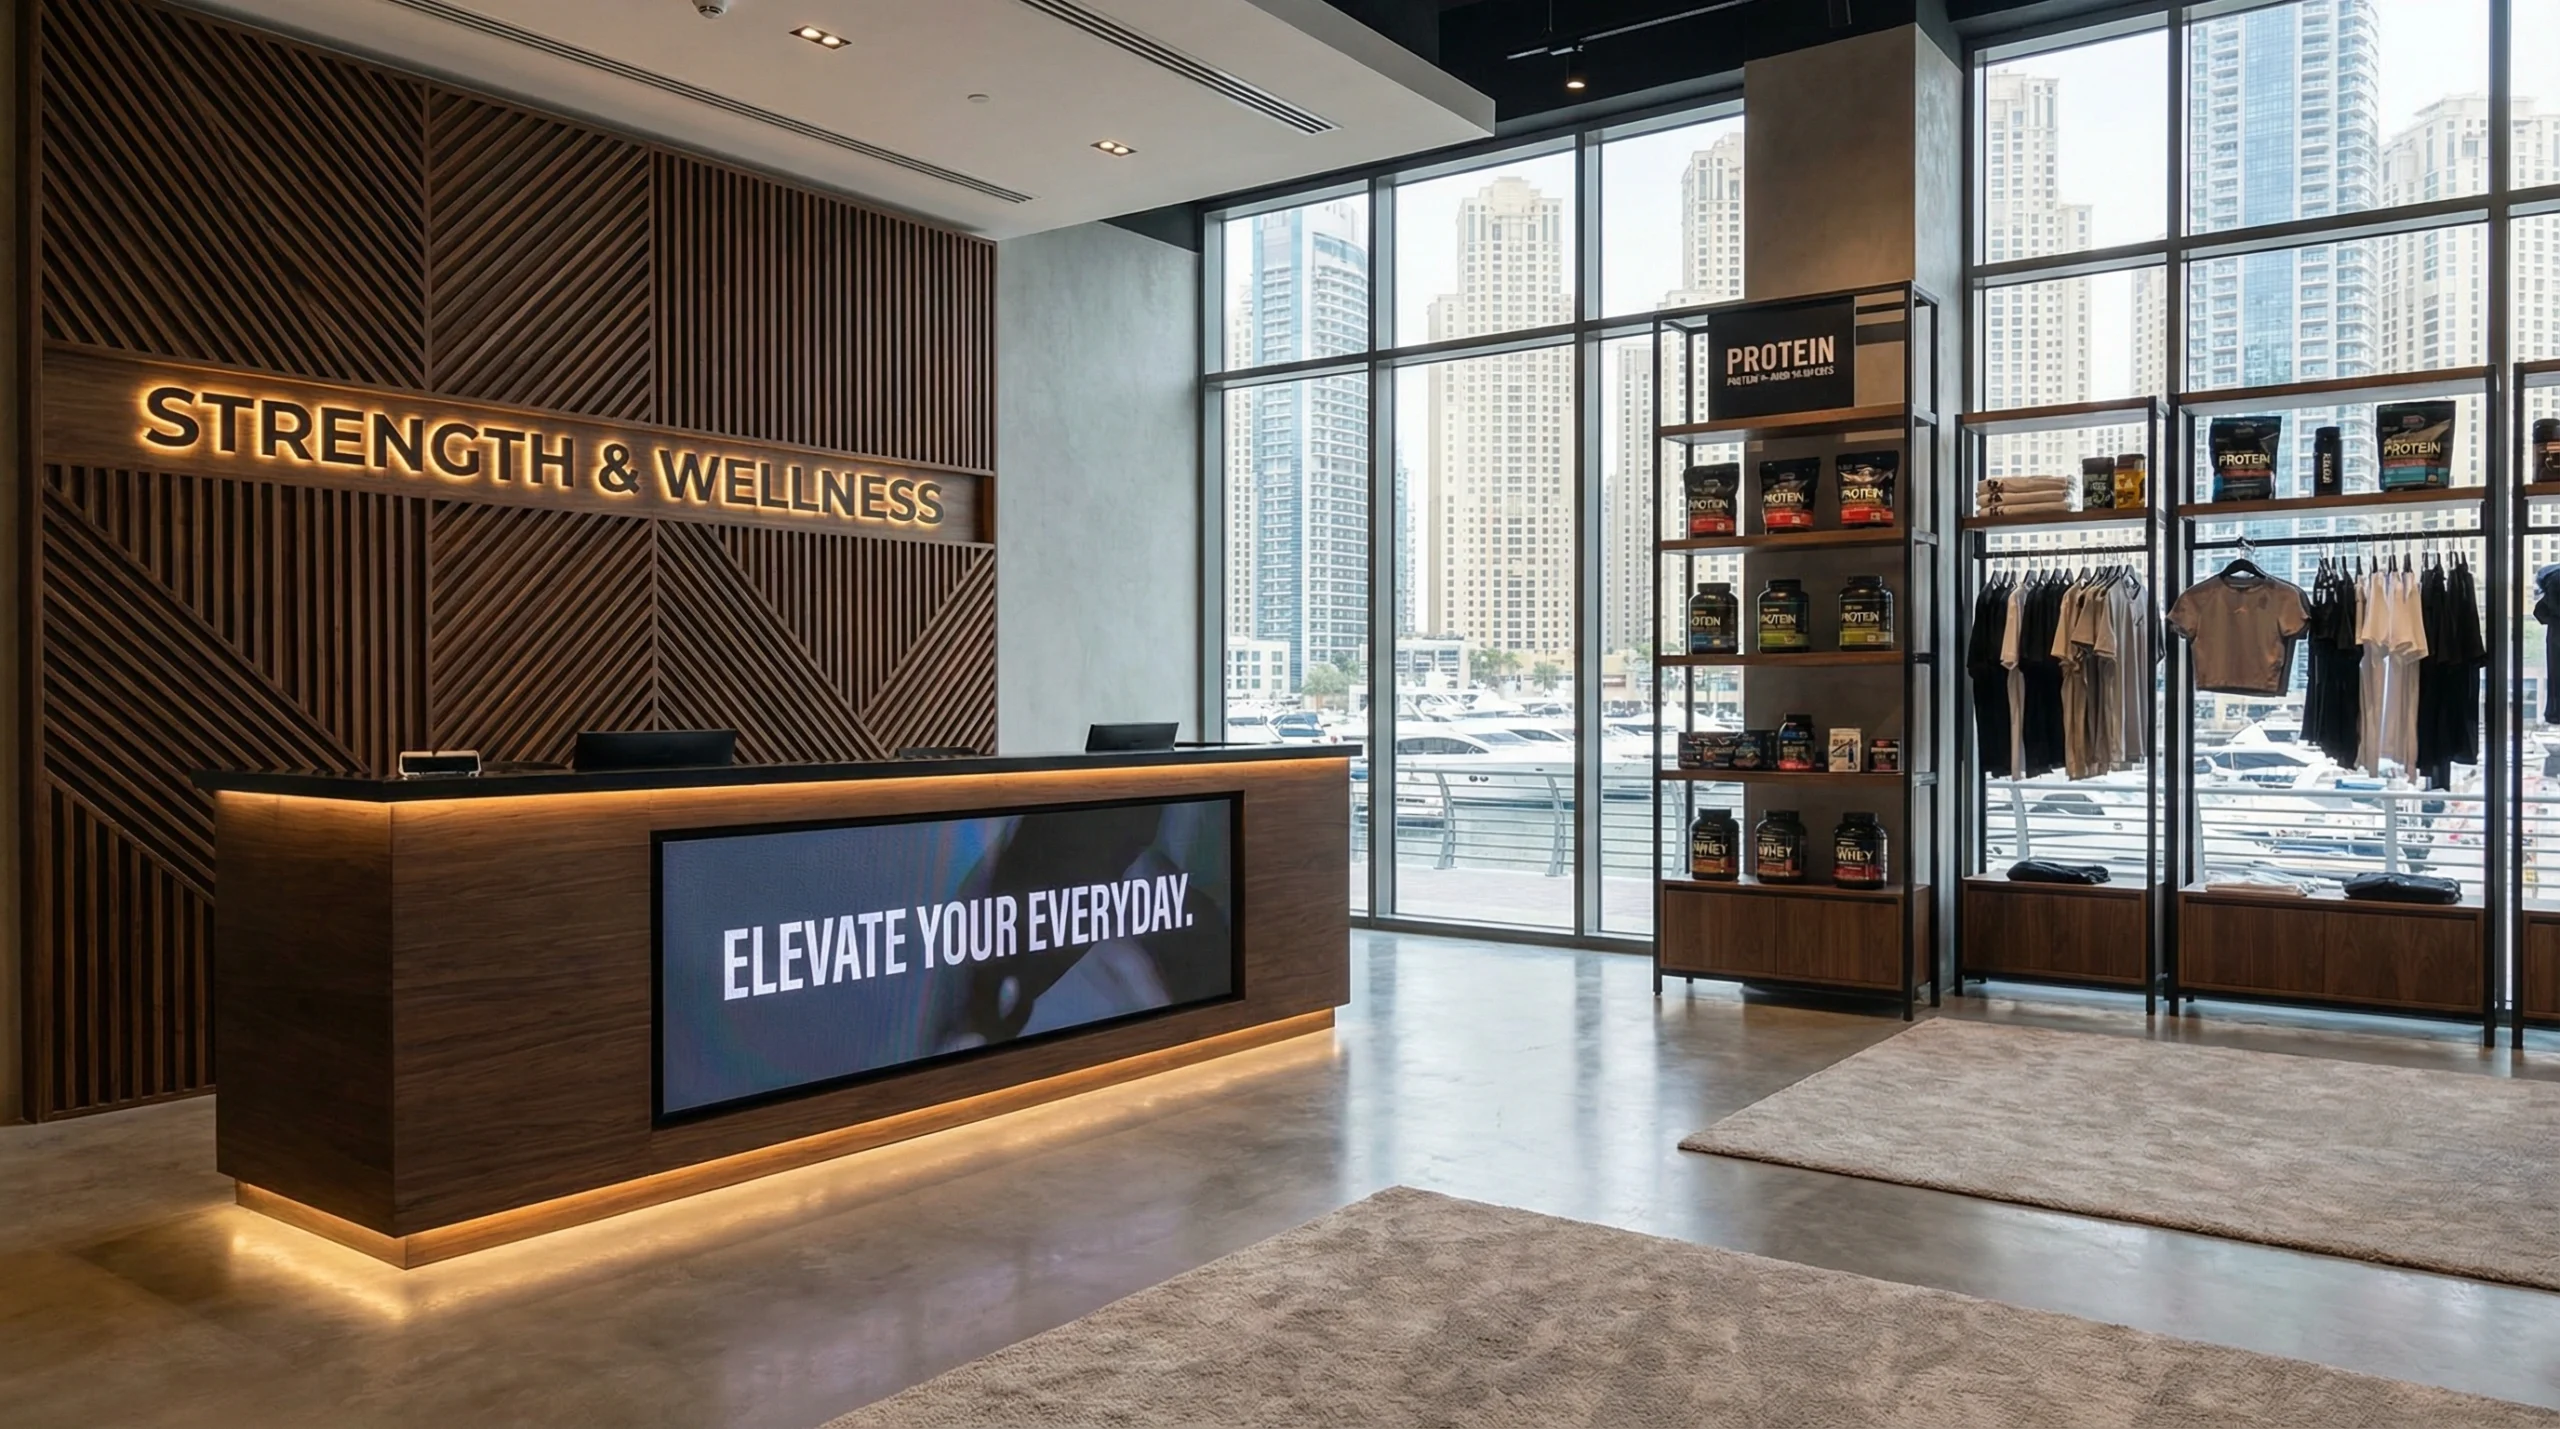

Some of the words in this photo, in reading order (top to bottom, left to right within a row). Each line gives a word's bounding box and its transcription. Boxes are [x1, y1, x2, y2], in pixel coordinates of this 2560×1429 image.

[1727, 335, 1835, 375] PROTEIN
[144, 384, 577, 490] STRENGTH
[597, 439, 641, 495] &
[658, 447, 945, 525] WELLNESS
[723, 908, 908, 1001] ELEVATE
[916, 894, 1018, 969] YOUR
[1028, 873, 1194, 952] EVERYDAY.
